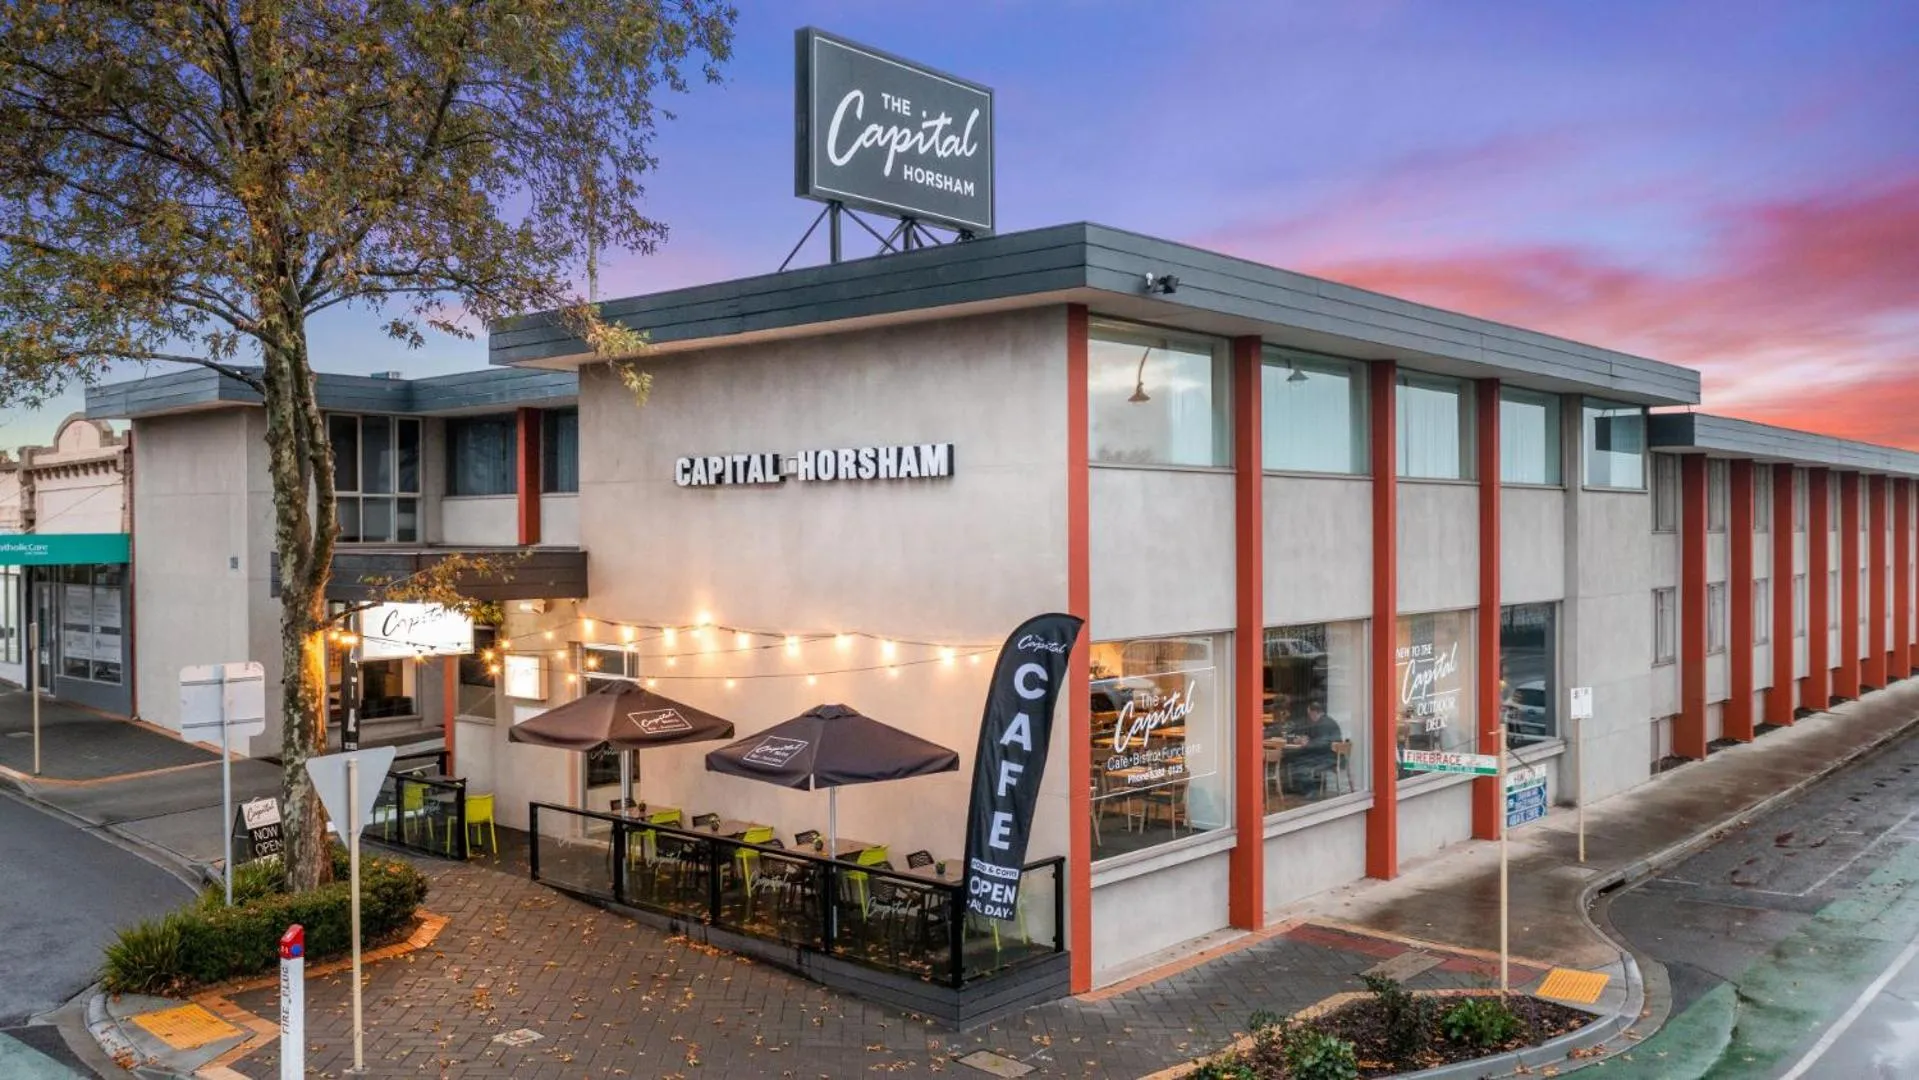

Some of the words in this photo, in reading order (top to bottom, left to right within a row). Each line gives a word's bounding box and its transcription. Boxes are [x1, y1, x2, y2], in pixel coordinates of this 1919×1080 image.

[881, 92, 911, 116] THE
[827, 89, 980, 177] Capital
[903, 164, 975, 197] HORSHAM
[675, 453, 783, 487] CAPITAL
[797, 443, 952, 481] HORSHAM
[1017, 634, 1067, 654] Capital
[1402, 642, 1457, 704] Capital
[1140, 693, 1159, 708] The
[1114, 679, 1195, 753] Capital
[989, 662, 1049, 850] CAFE
[1406, 751, 1462, 766] FIREBRACE
[253, 826, 279, 841] NOW
[255, 839, 283, 857] OPEN
[970, 875, 1016, 904] OPEN
[984, 904, 1010, 918] DAY
[282, 966, 290, 997] PLUG
[282, 1007, 291, 1034] FIRE
